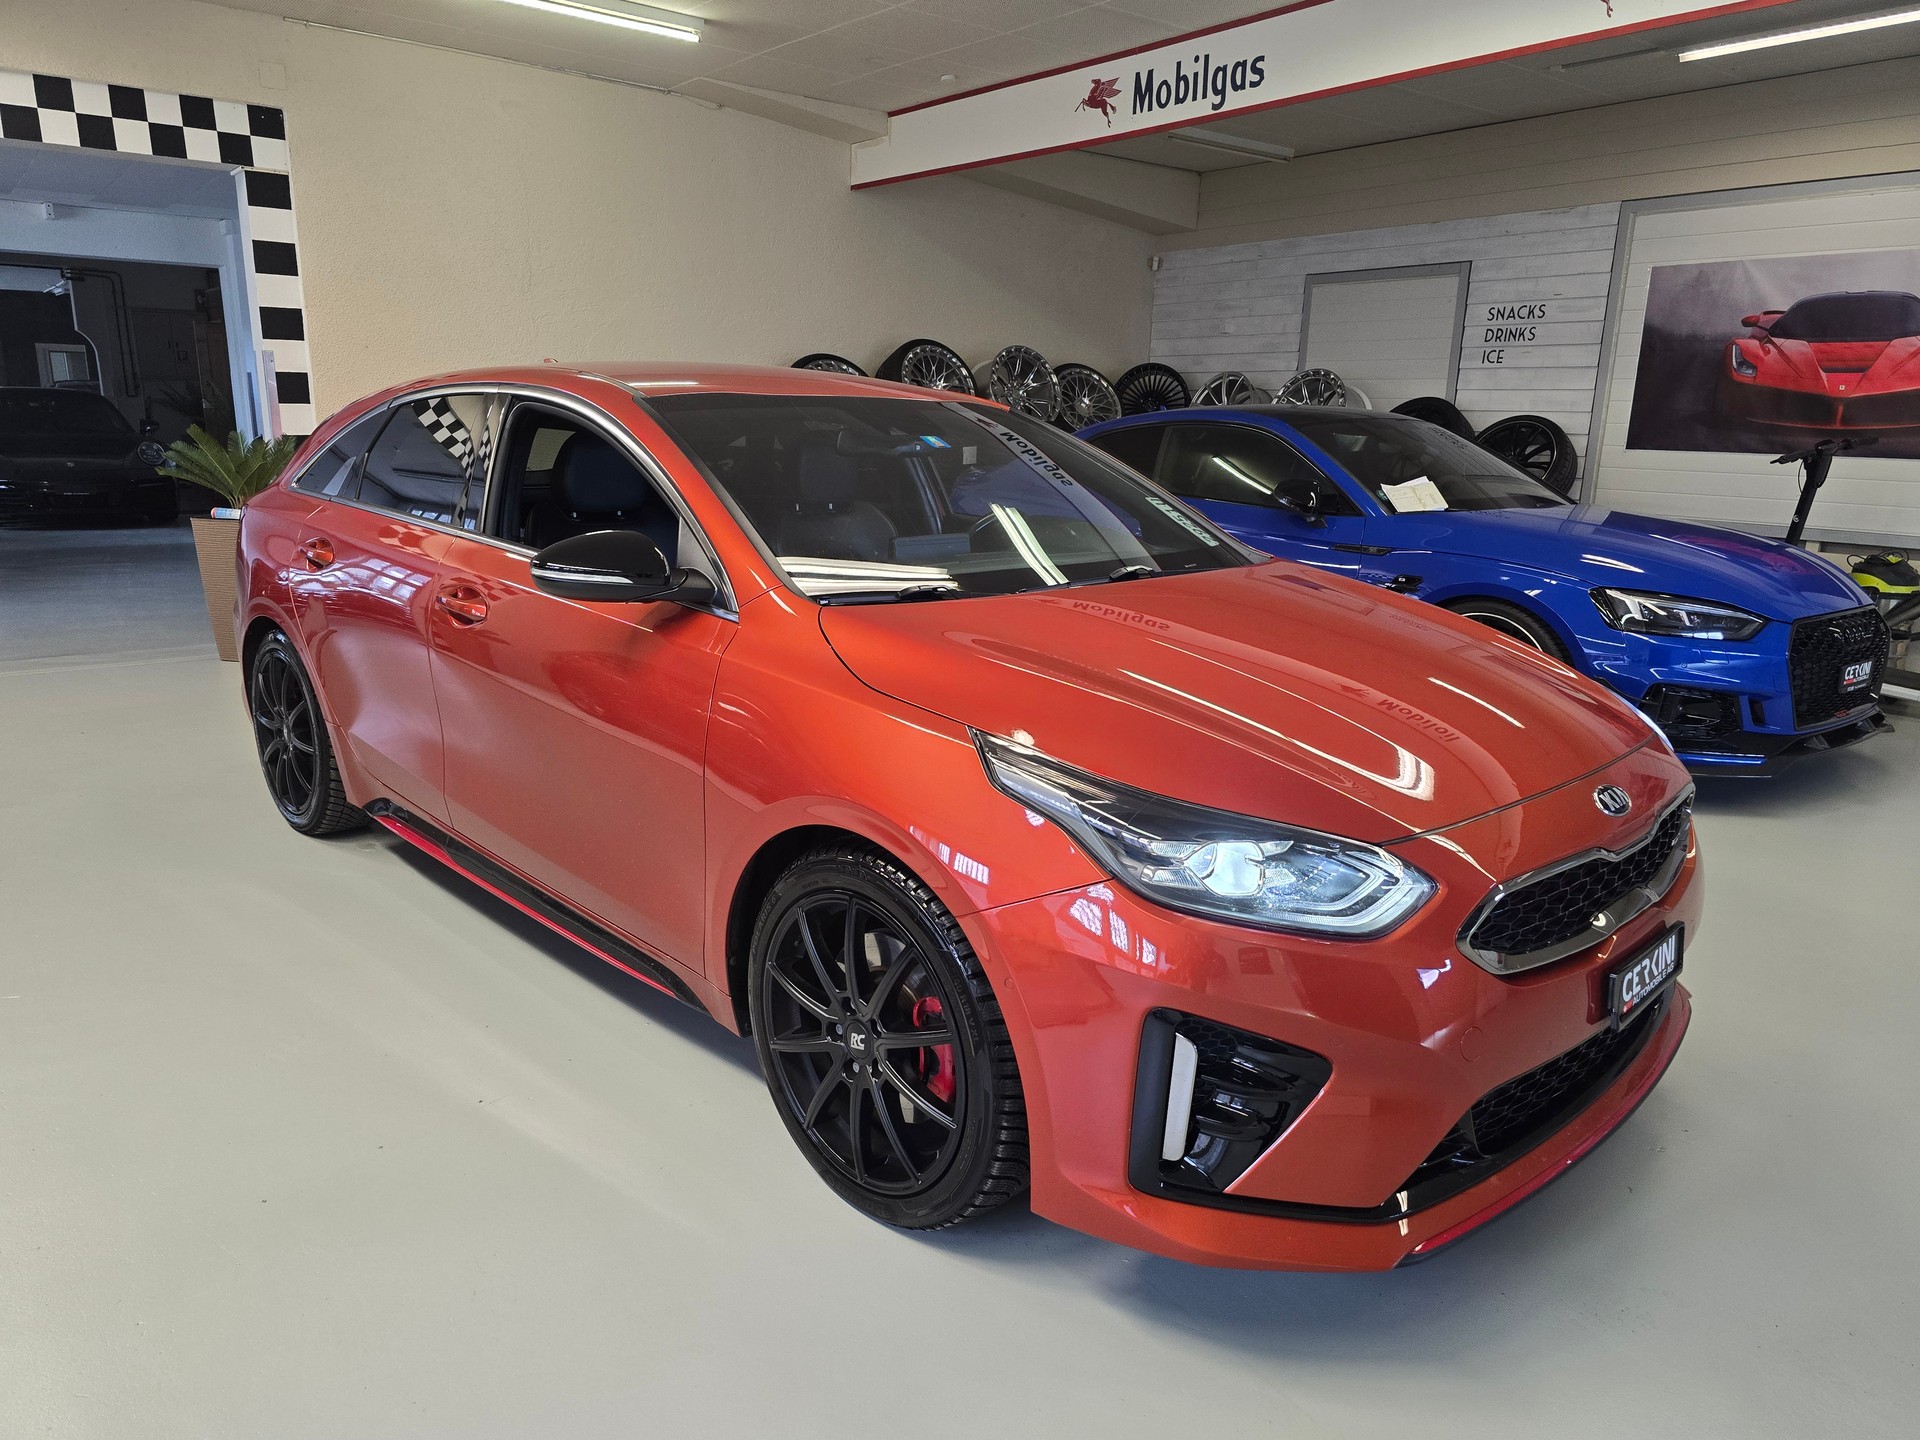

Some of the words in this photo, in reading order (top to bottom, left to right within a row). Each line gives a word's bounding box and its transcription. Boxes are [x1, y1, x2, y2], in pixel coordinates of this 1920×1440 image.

[1131, 53, 1266, 115] Mobilgas
[1487, 304, 1546, 321] SNACKS
[1484, 326, 1537, 342] DRINKS
[1481, 349, 1505, 364] ICE
[1598, 786, 1629, 811] KIA
[850, 1032, 866, 1050] RC
